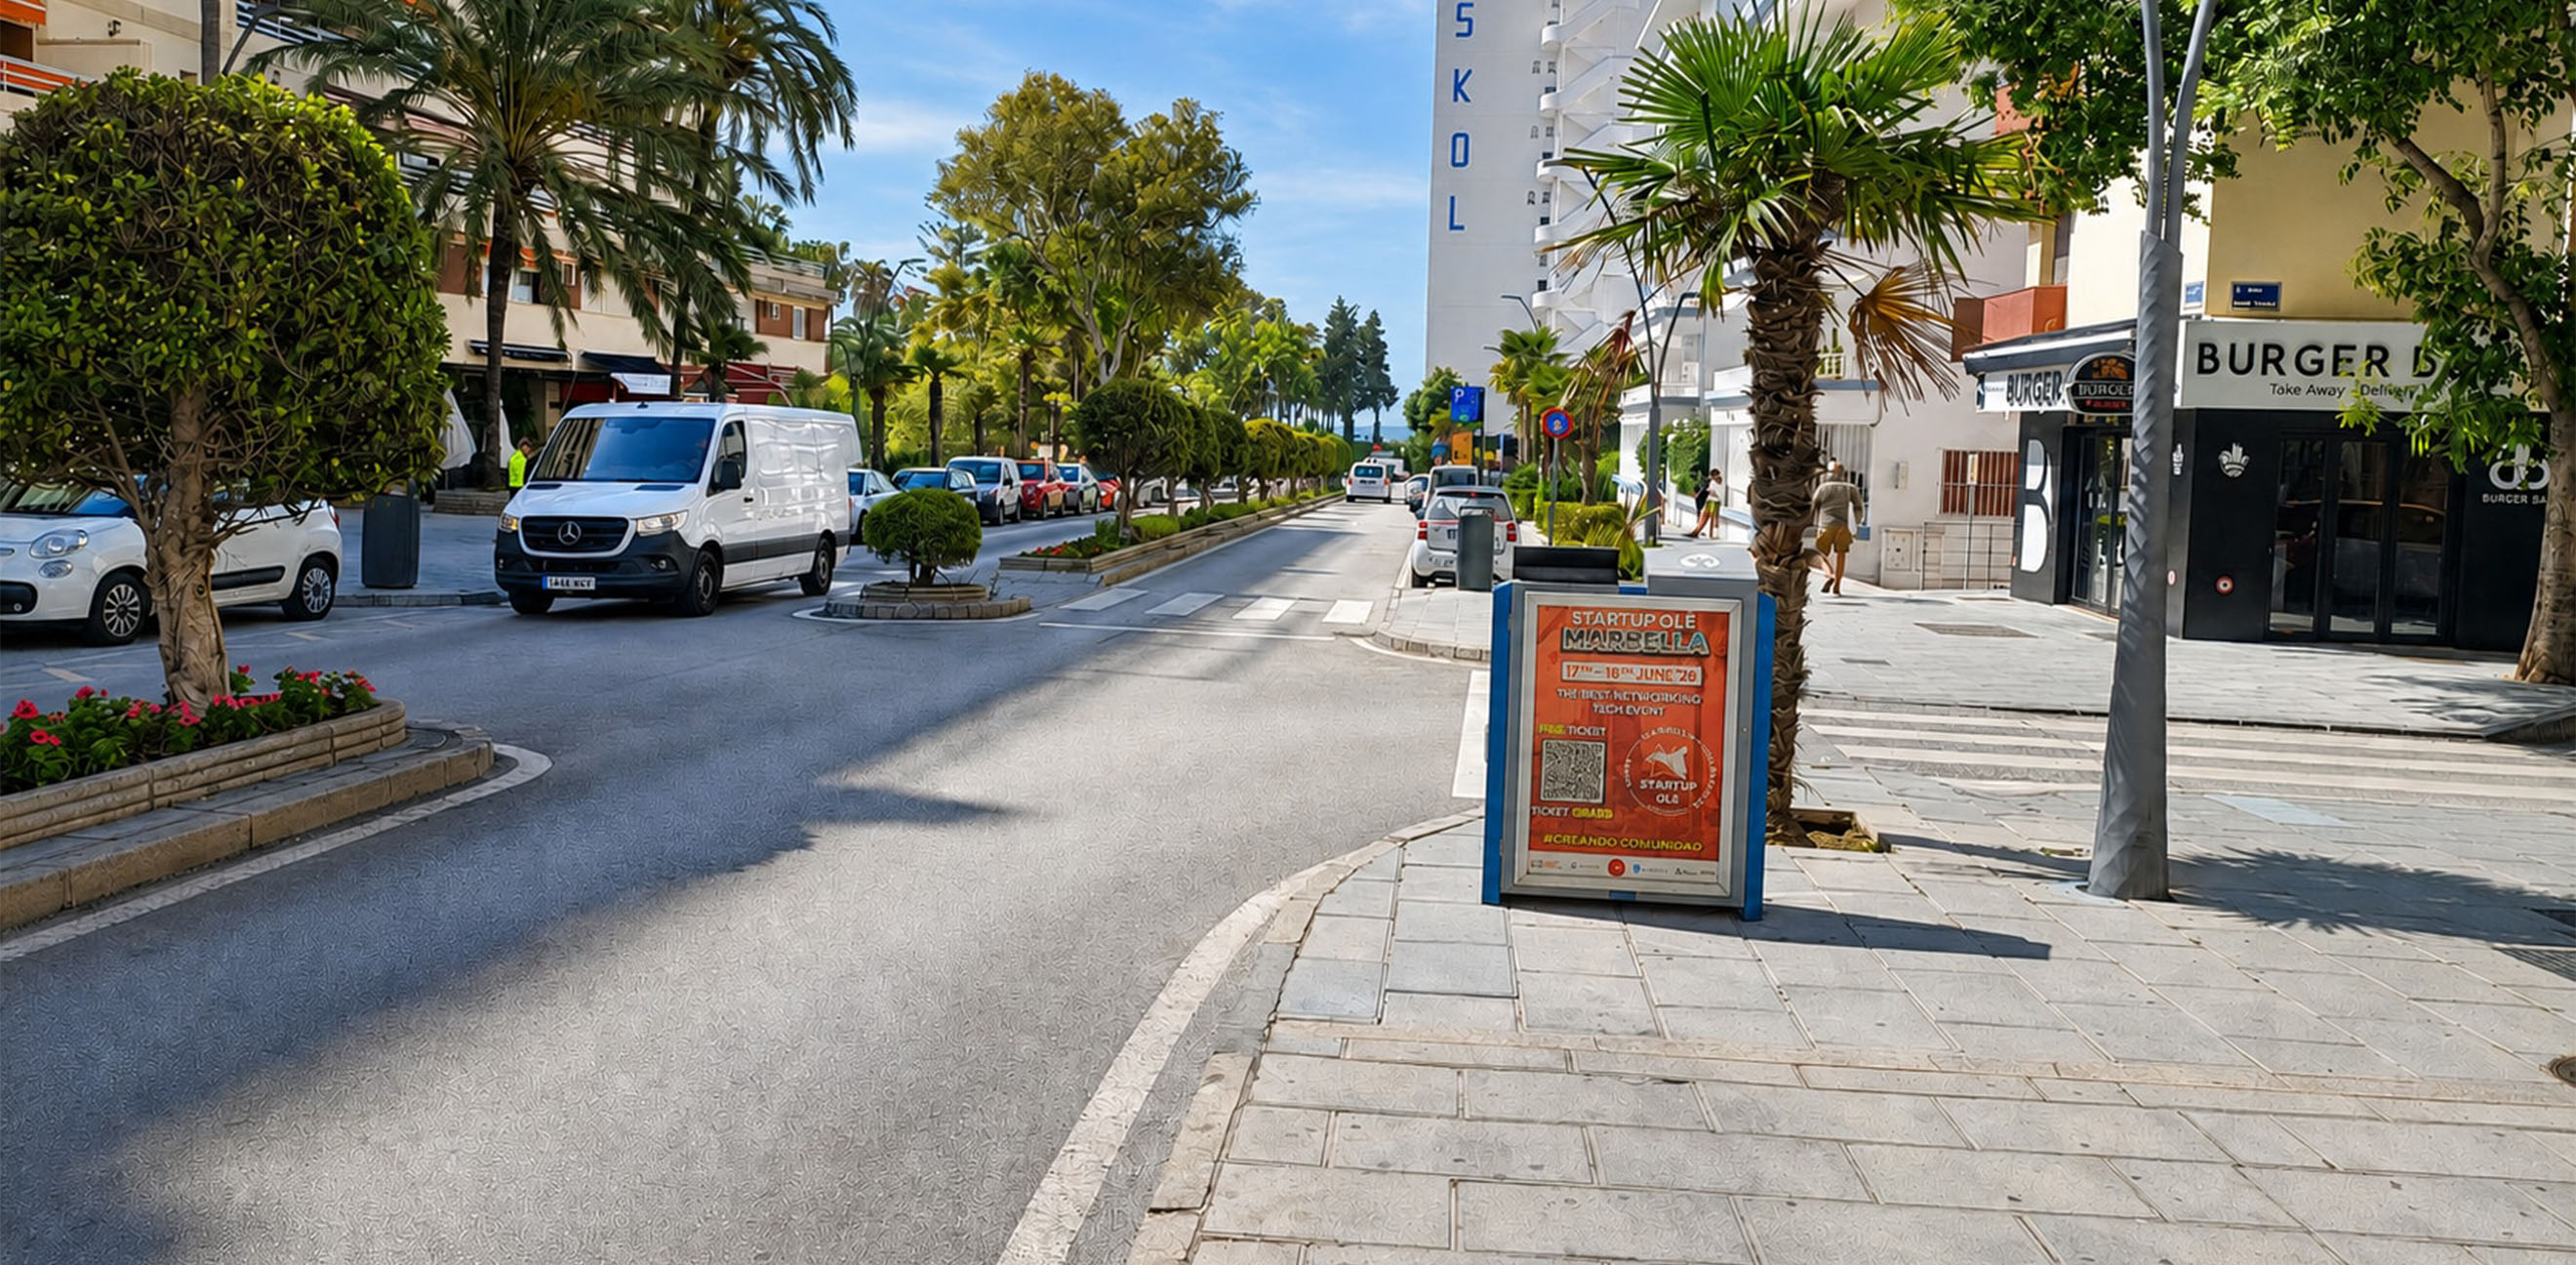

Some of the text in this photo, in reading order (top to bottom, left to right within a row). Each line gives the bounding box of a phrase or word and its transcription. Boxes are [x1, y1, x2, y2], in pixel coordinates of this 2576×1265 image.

[1448, 2, 1474, 231] SKOL
[2196, 343, 2391, 378] BURGER
[2006, 370, 2064, 406] BURGER
[2270, 383, 2302, 395] Take
[2305, 383, 2346, 399] Away
[2481, 493, 2528, 505] BURGER
[1572, 611, 1656, 628] STARTUP
[1561, 627, 1711, 656] MARBELLA
[1635, 668, 1674, 682] JUNE
[1613, 690, 1703, 705] NETWORKING
[1626, 705, 1666, 716] EVENT
[1640, 779, 1698, 792] STARTUP
[1543, 833, 1704, 852] #CREANDO COMUNIDAD
